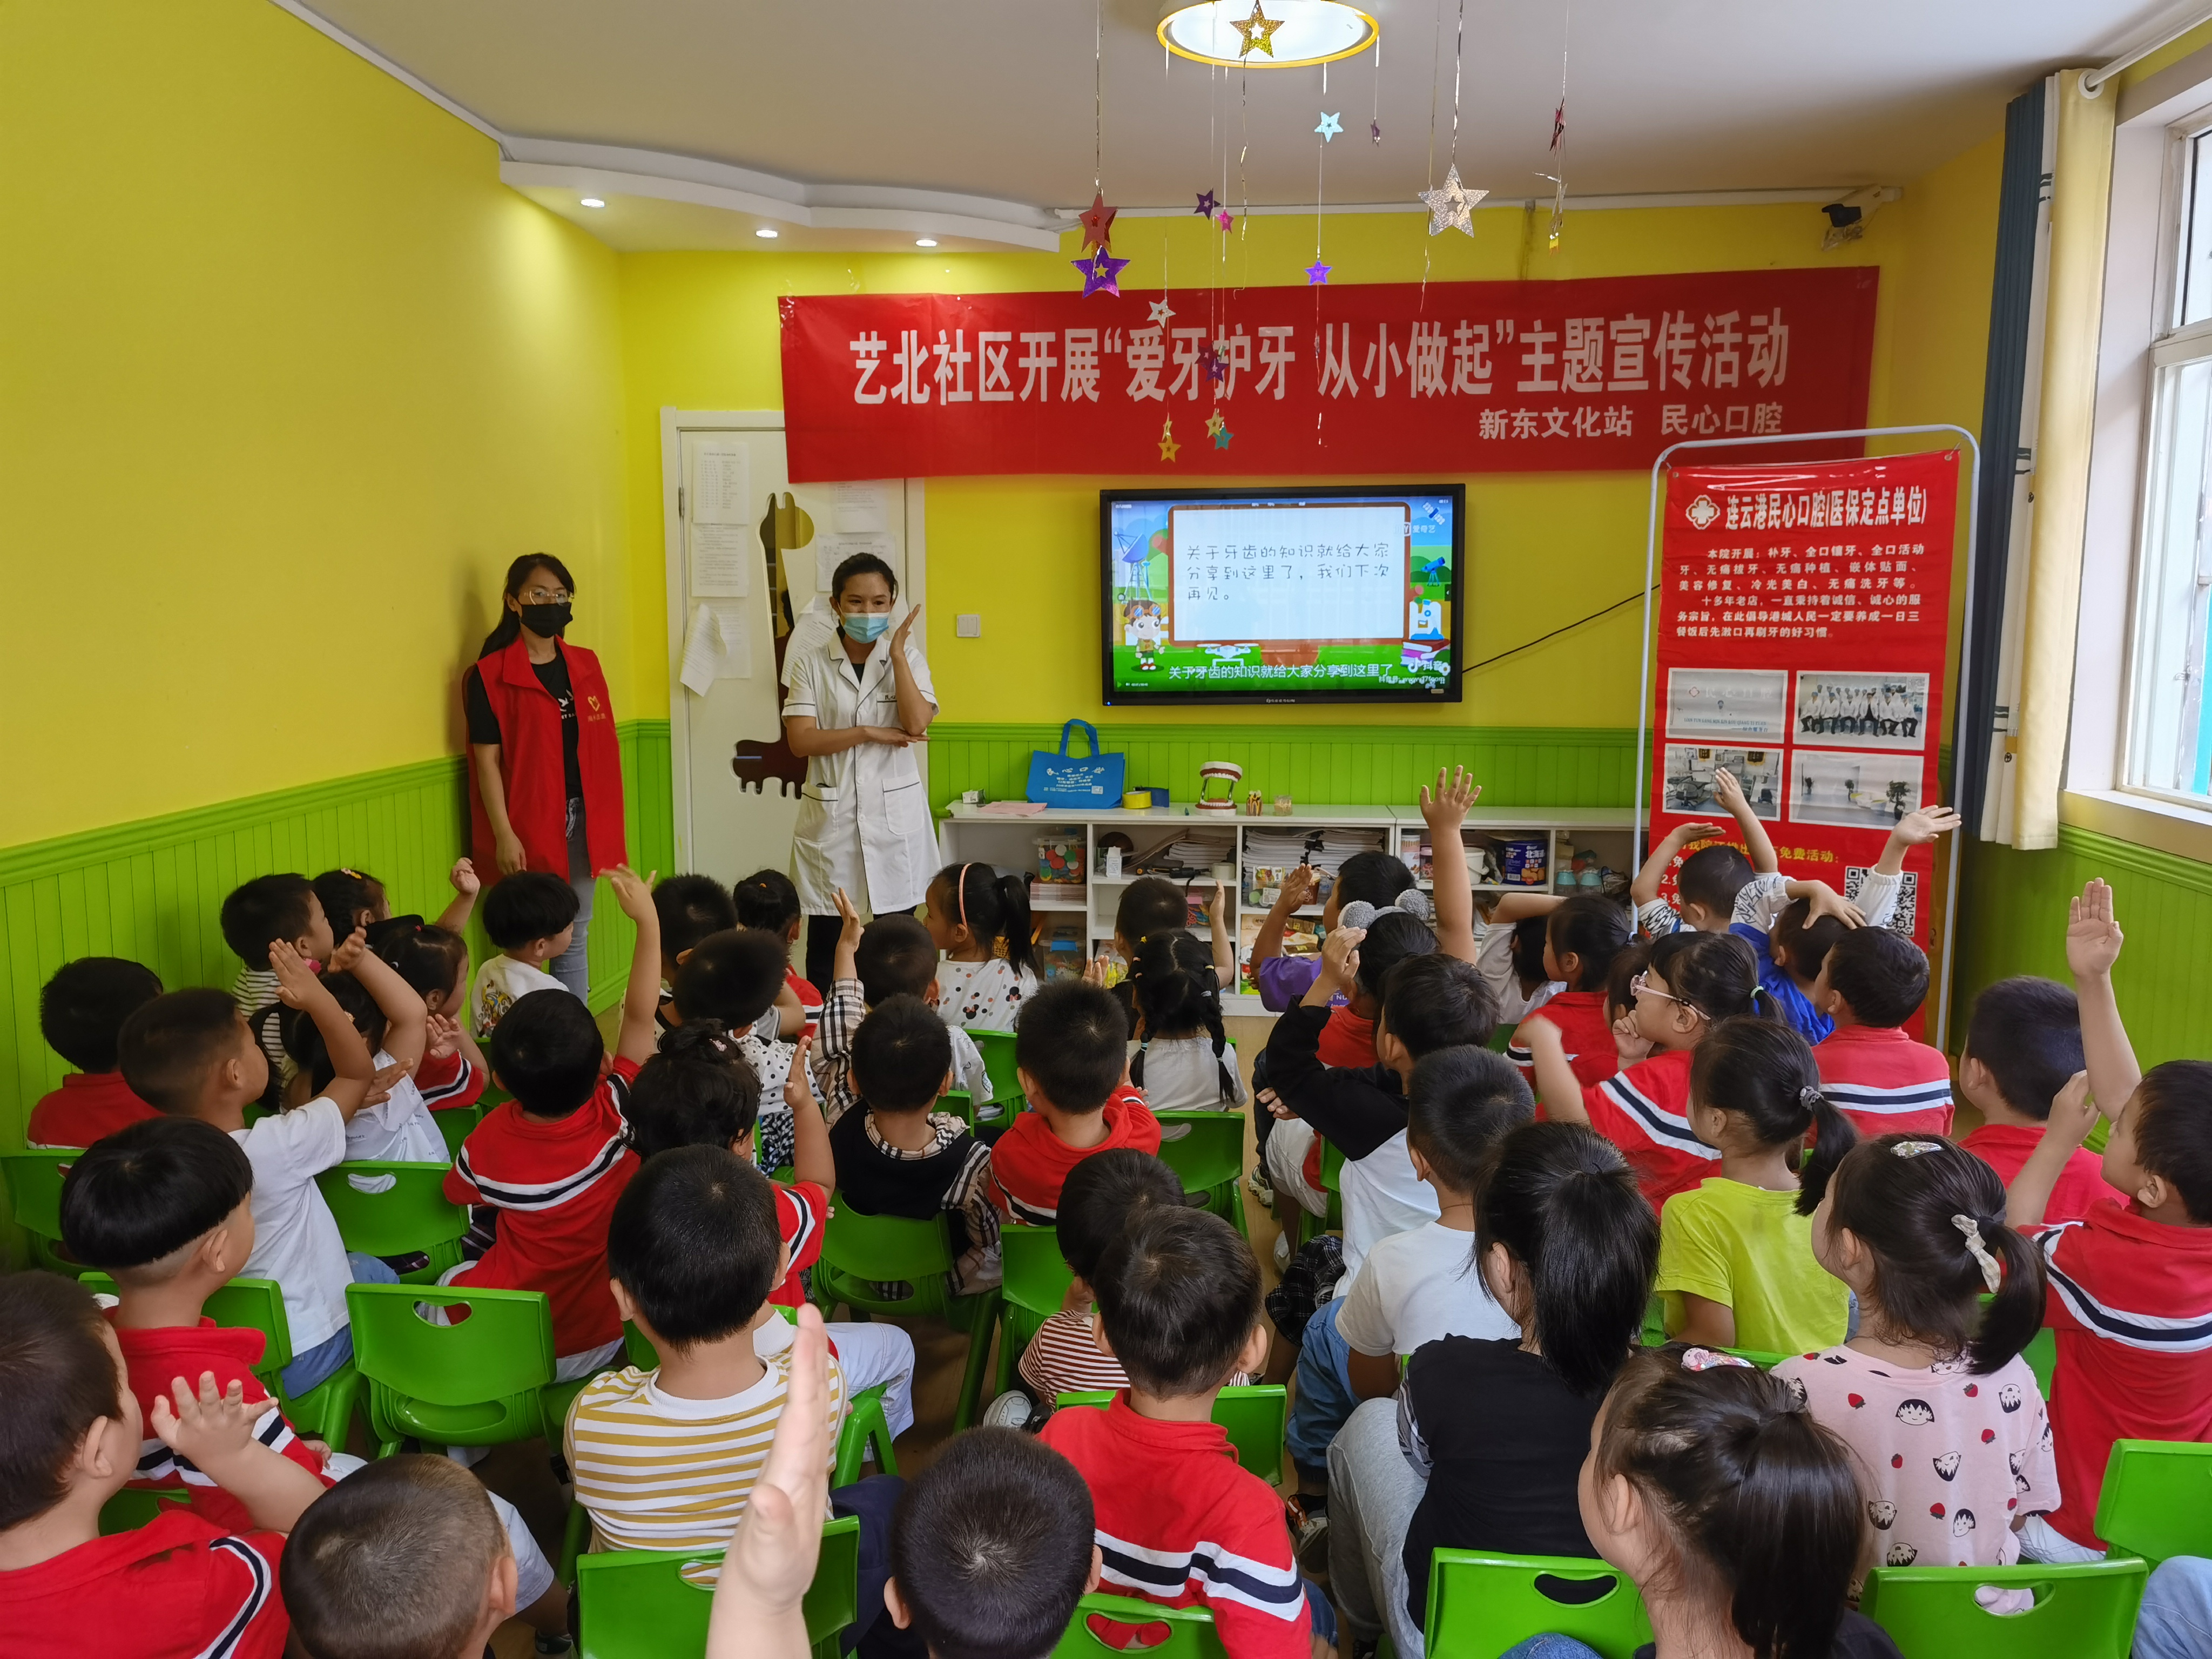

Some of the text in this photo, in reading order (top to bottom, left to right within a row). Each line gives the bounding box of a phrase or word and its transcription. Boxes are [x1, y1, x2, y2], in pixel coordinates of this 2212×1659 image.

[1479, 402, 1783, 440] 新东文化站 民心口腔
[1187, 542, 1389, 559] 关于牙齿的知识就给大家
[1188, 586, 1229, 601] 再见。
[1169, 663, 1393, 680] 关于牙齿的知识就给大家分享到这里了
